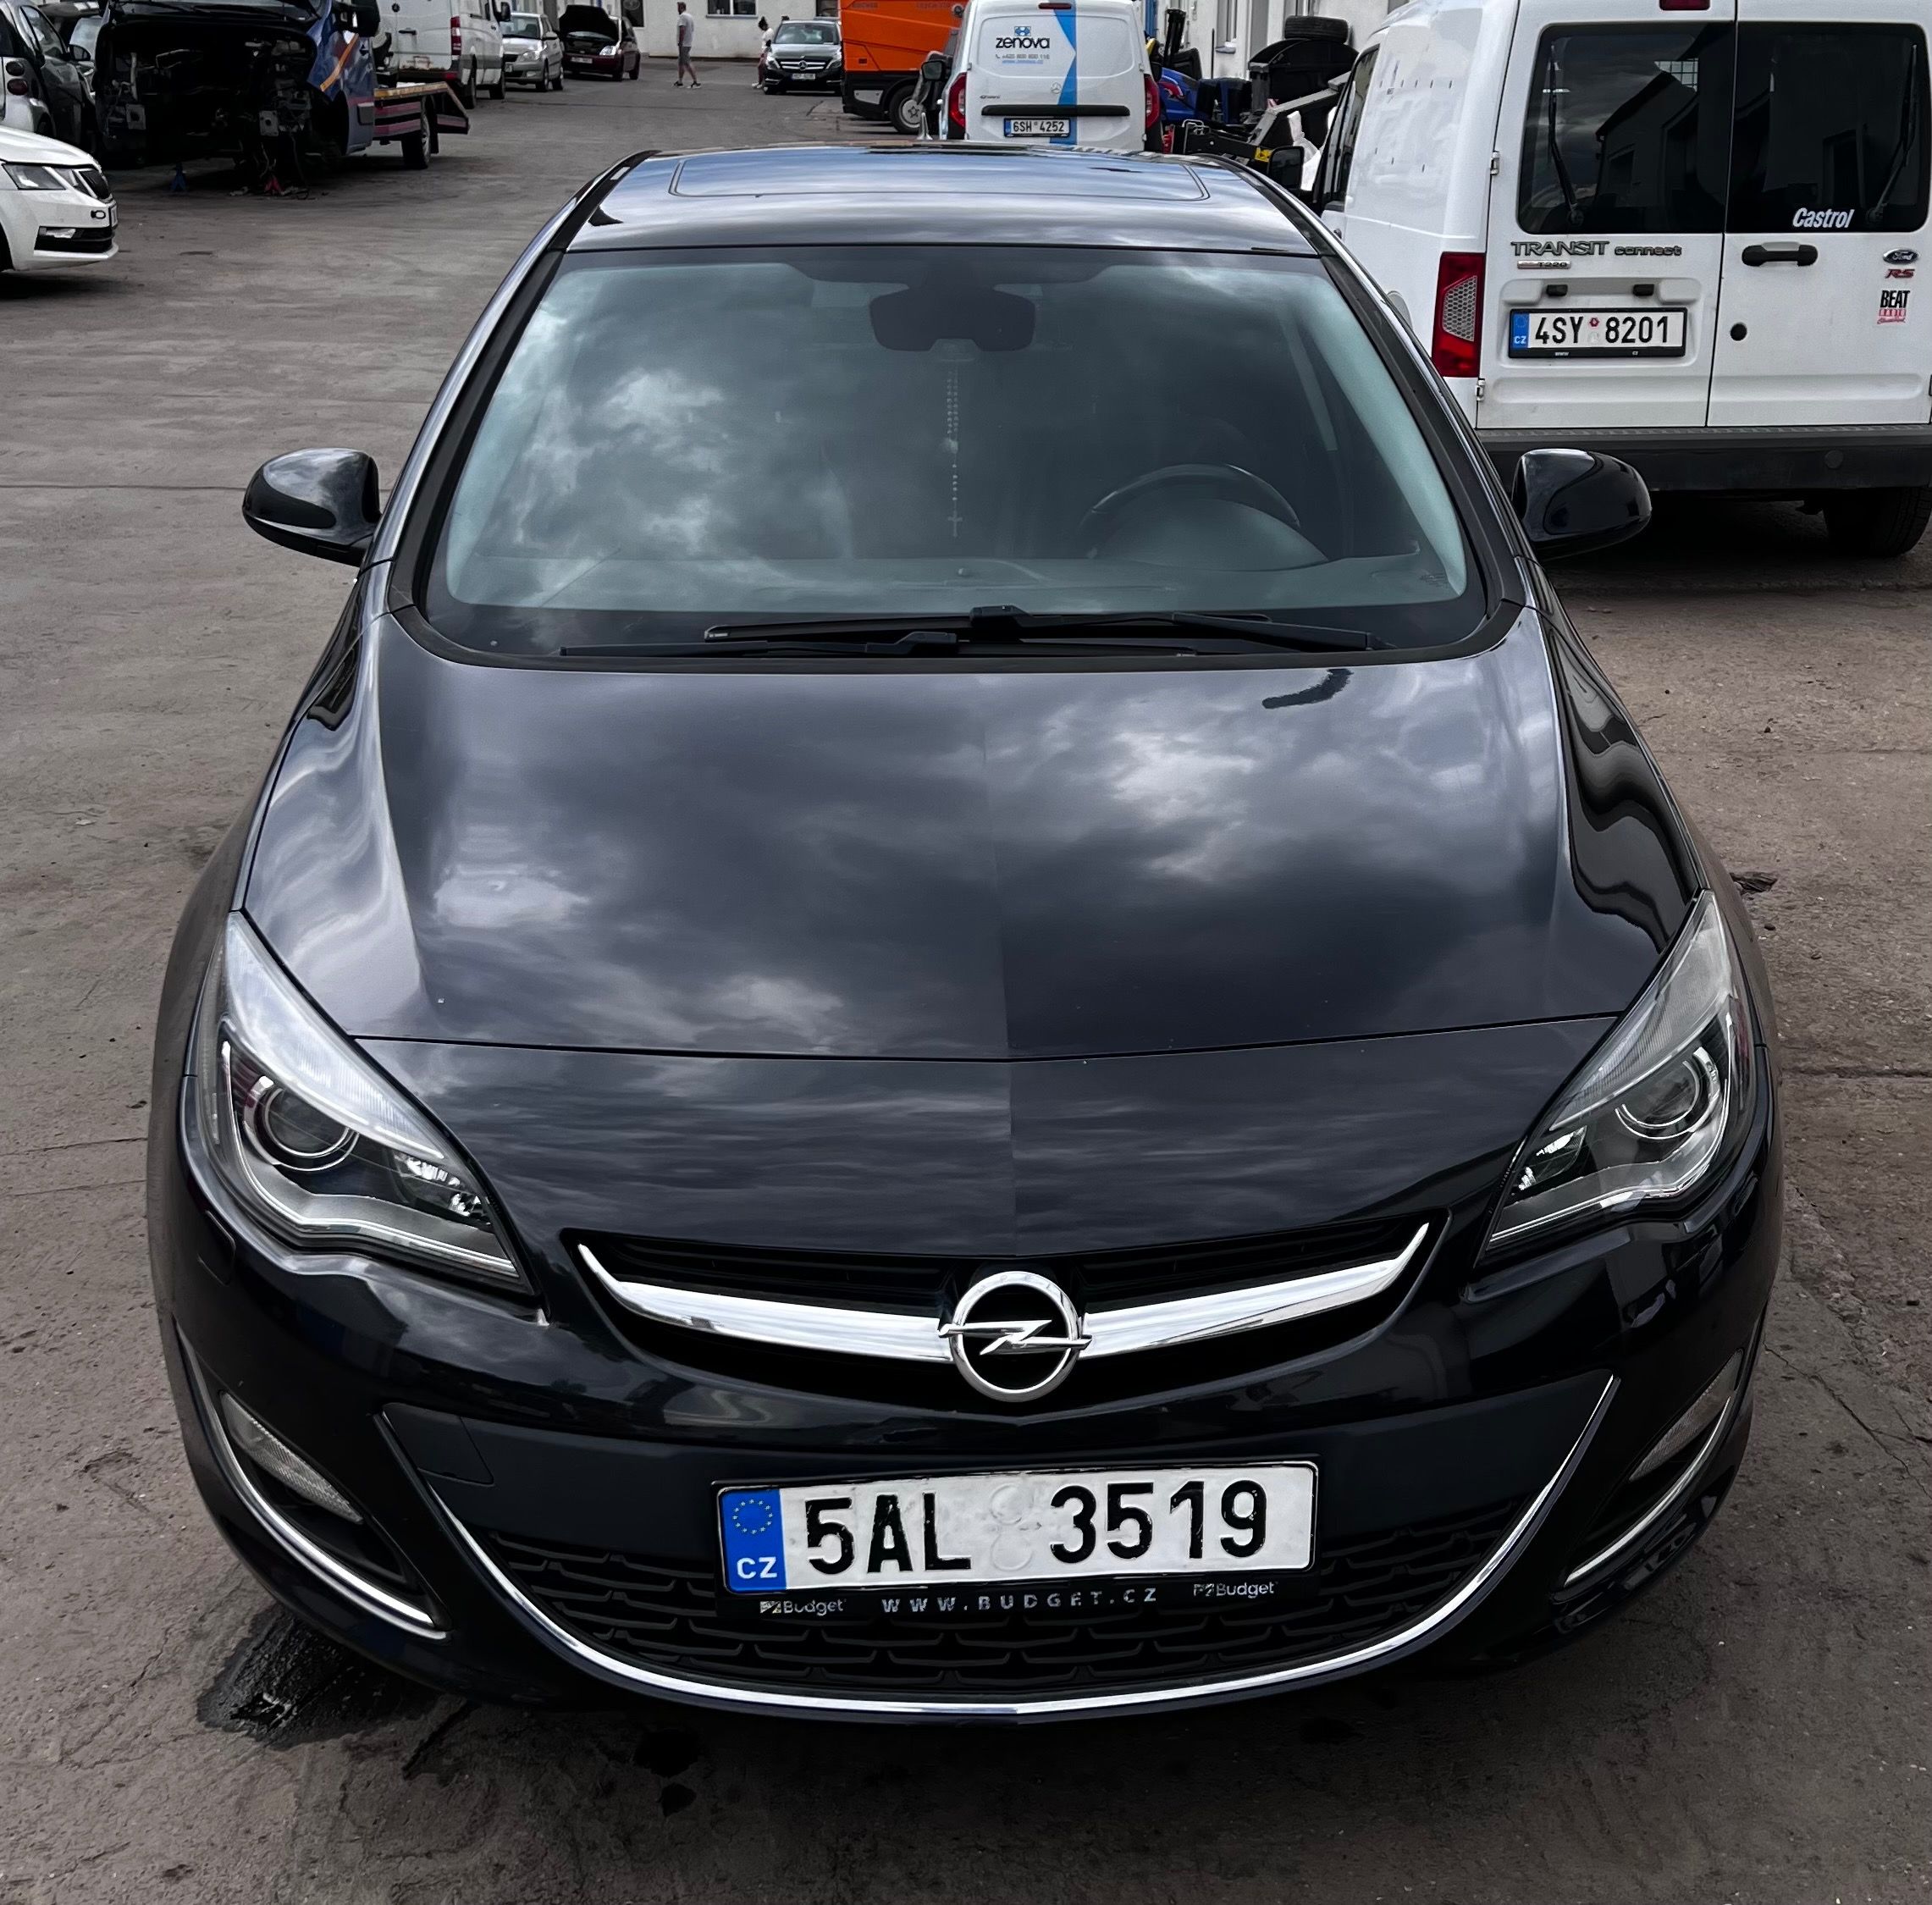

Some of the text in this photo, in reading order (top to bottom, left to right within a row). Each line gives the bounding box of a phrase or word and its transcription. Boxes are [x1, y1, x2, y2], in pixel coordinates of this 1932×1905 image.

[996, 37, 1050, 48] zenova
[1013, 121, 1032, 132] 6SH
[1040, 121, 1064, 132] 4252
[1792, 207, 1855, 228] Castrol
[1510, 240, 1682, 257] TRANSIT connect
[1880, 290, 1911, 308] BEAT
[1535, 316, 1668, 344] 4SY 8201
[1514, 335, 1527, 345] CZ
[805, 1479, 1267, 1575] 5AL 3519
[737, 1556, 777, 1579] CZ
[1216, 1582, 1275, 1599] Budget
